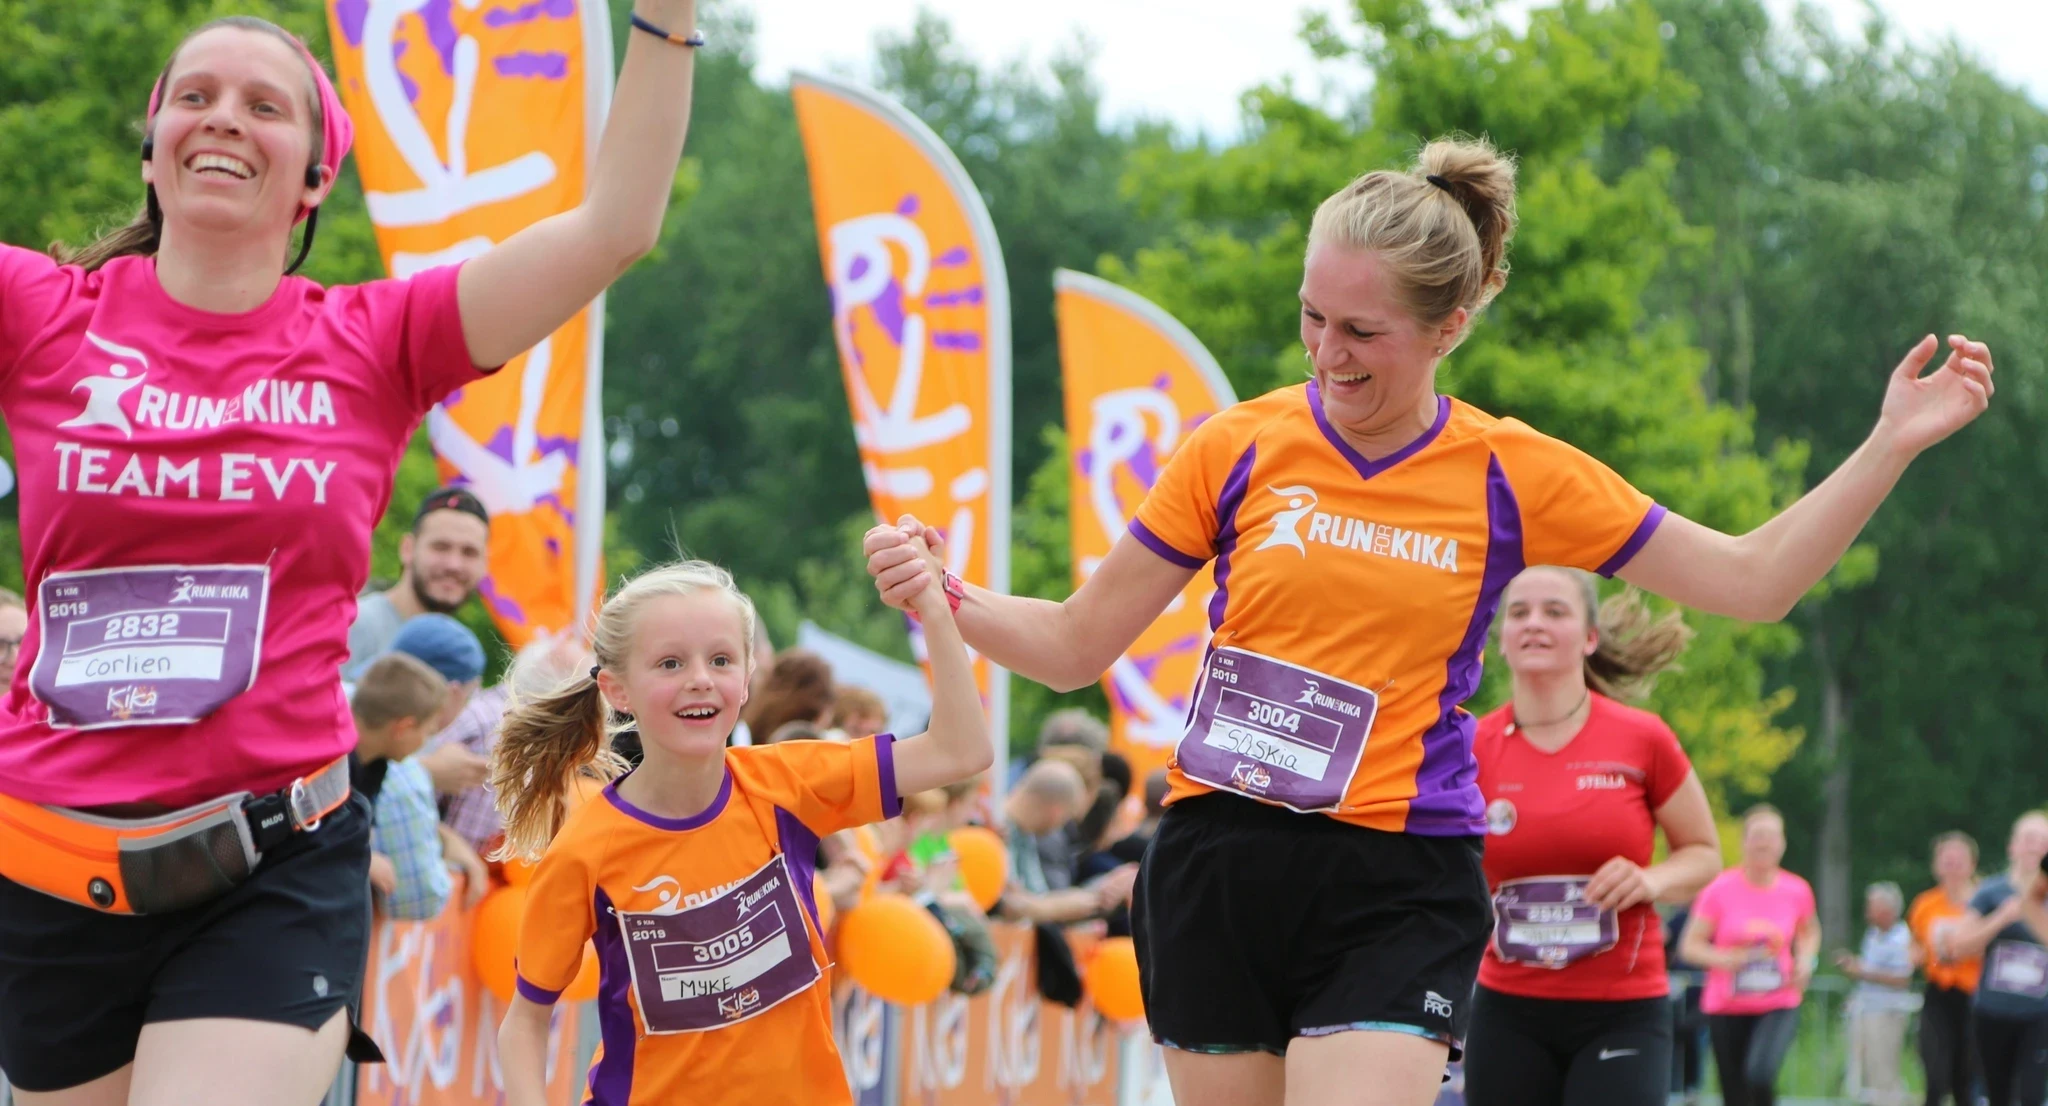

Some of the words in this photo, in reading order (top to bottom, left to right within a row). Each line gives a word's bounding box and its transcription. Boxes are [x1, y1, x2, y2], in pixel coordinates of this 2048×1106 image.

[135, 384, 227, 429] RUN
[242, 379, 336, 426] KIKA
[54, 442, 200, 498] TEAM
[218, 453, 338, 504] EVY
[1308, 511, 1375, 552] RUN
[1373, 524, 1392, 556] FOR
[1390, 527, 1458, 573] KIKA
[55, 588, 62, 597] 5
[63, 587, 78, 596] KM
[191, 585, 216, 598] RUN
[220, 585, 249, 599] KIKA
[49, 602, 88, 618] 2019
[104, 614, 179, 640] 2832
[85, 654, 171, 677] Corlien
[1218, 656, 1223, 664] 5
[1223, 657, 1234, 667] KM
[1211, 667, 1238, 684] 2019
[106, 685, 157, 711] Kika
[1314, 692, 1336, 709] RUN
[1336, 700, 1361, 719] KIKA
[1248, 701, 1301, 734] 3004
[1231, 760, 1272, 788] Kika
[1575, 774, 1626, 791] STELLA
[746, 890, 763, 908] RUN
[762, 876, 781, 896] KIKA
[632, 929, 667, 941] 2019
[693, 926, 754, 963] 3005
[681, 975, 734, 998] MYKE
[717, 988, 760, 1016] Kika
[1424, 999, 1453, 1018] PRO
